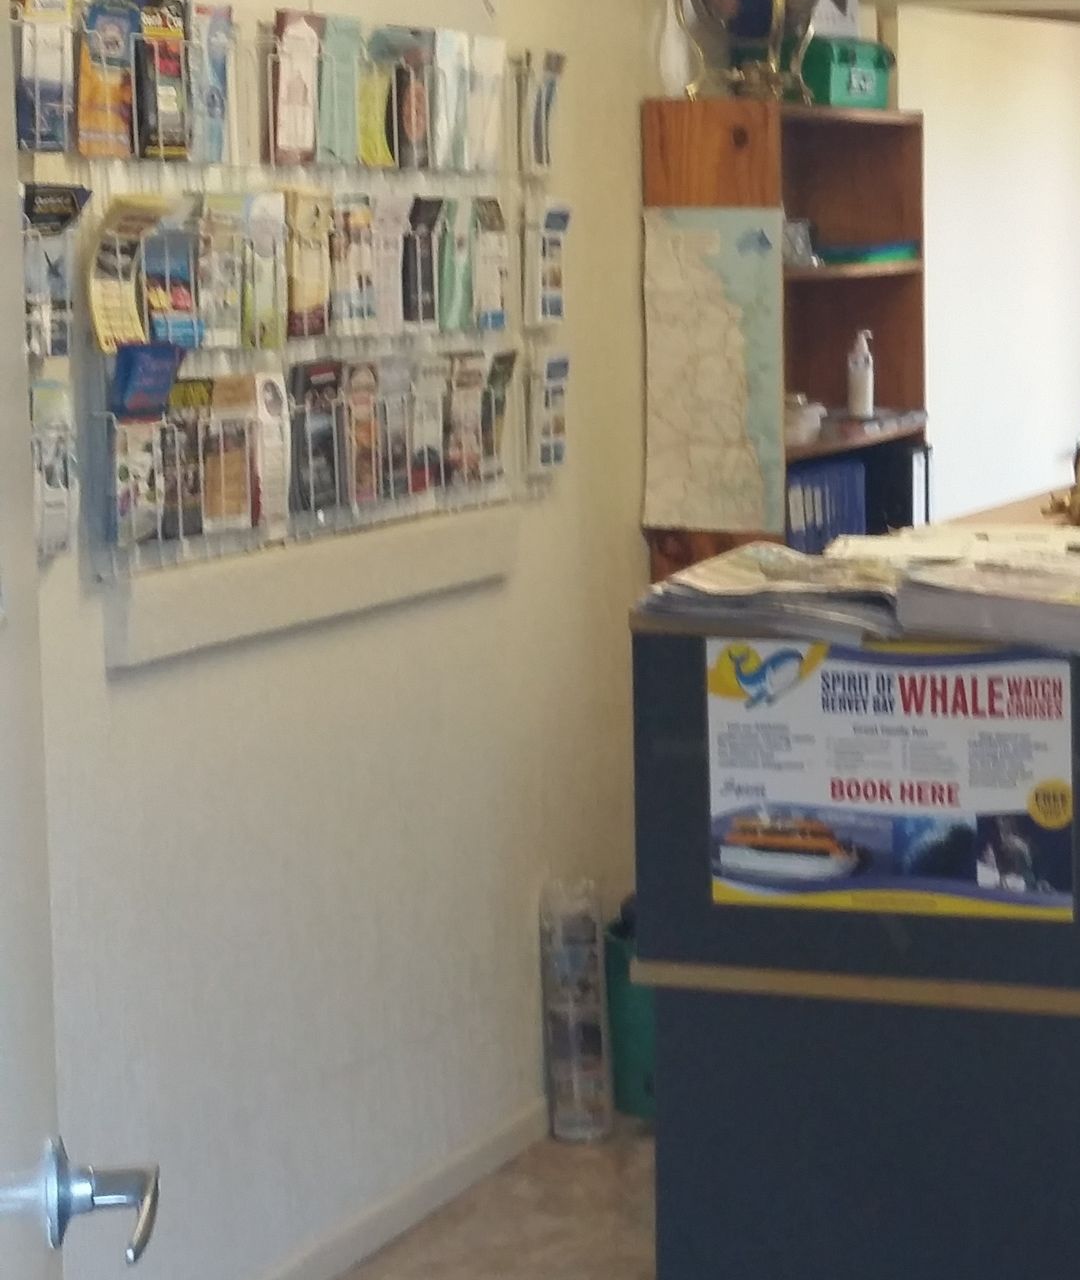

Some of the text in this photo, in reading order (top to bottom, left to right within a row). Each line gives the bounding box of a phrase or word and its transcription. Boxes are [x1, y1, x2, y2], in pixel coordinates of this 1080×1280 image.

[821, 672, 871, 696] SPIRIT
[899, 673, 1004, 719] WHALE
[1006, 677, 1063, 699] WATCH
[830, 776, 961, 807] BOOK HERE
